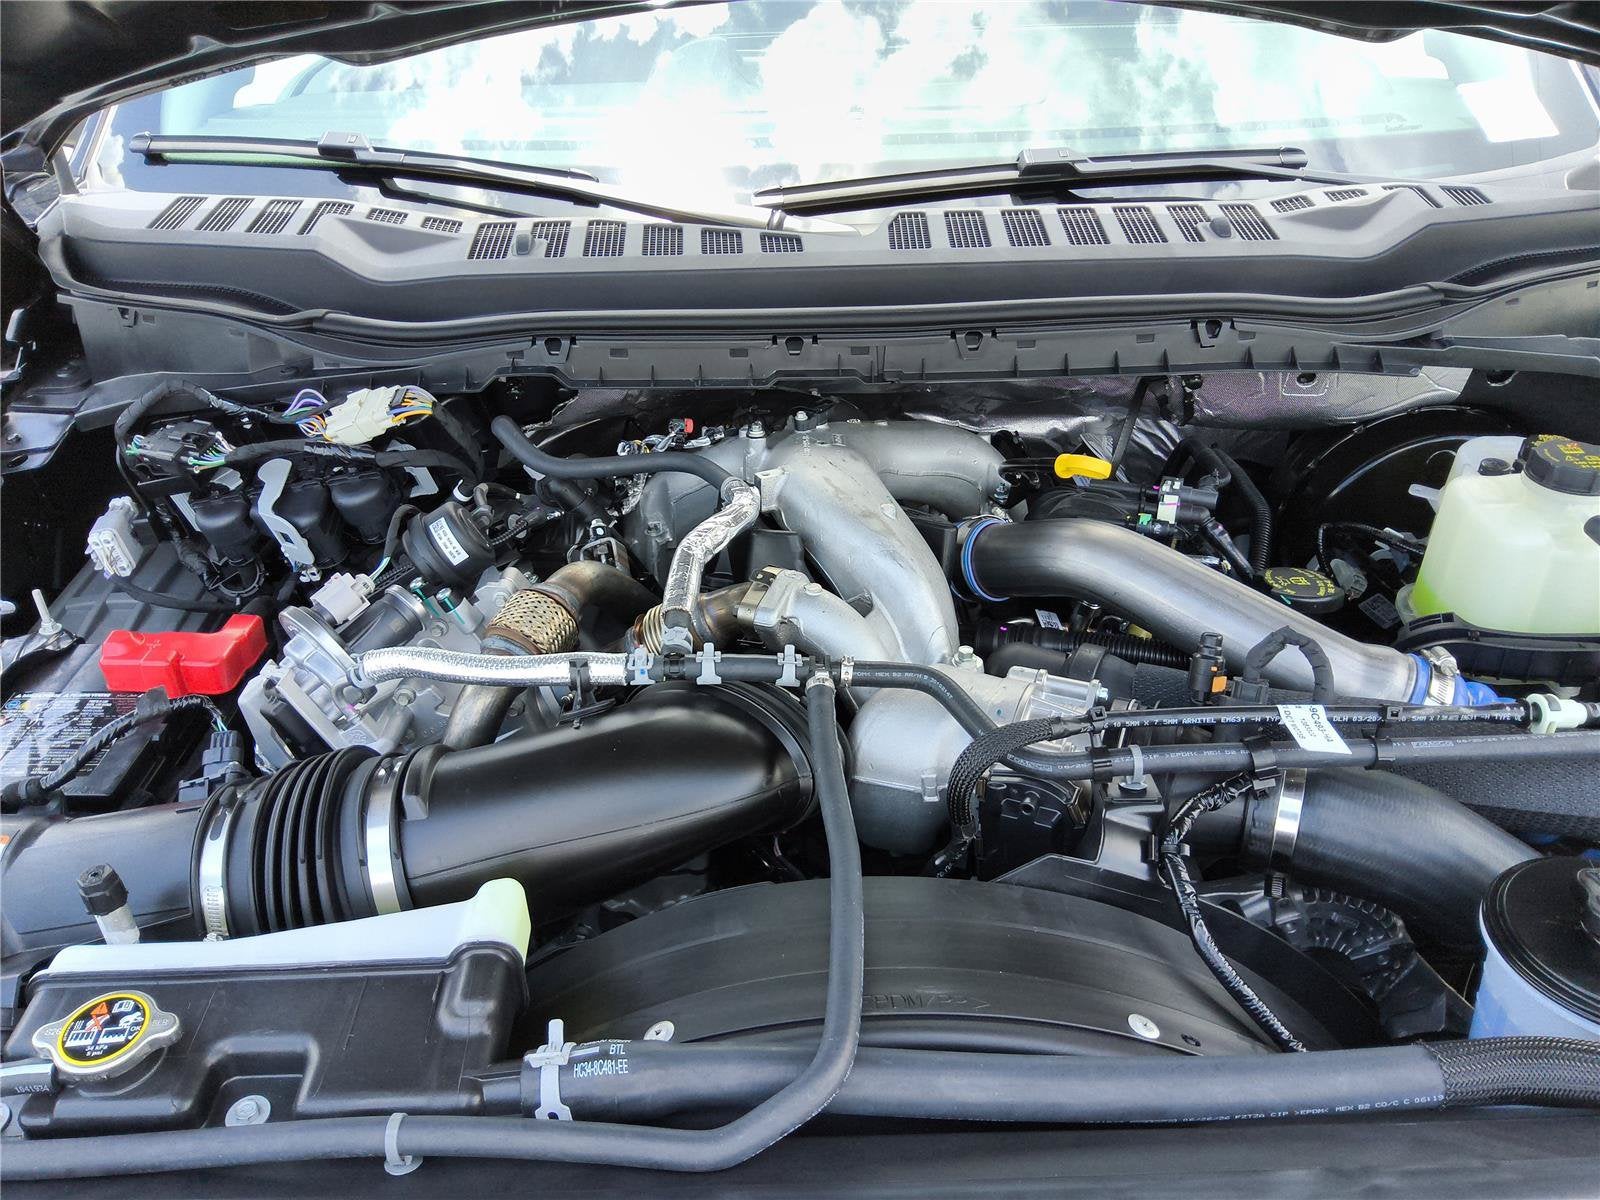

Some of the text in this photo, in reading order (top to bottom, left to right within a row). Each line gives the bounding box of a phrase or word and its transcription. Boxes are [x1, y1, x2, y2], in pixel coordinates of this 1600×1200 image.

[1181, 716, 1217, 725] ARNITEL
[130, 1024, 142, 1032] OK
[609, 1043, 626, 1055] BTL
